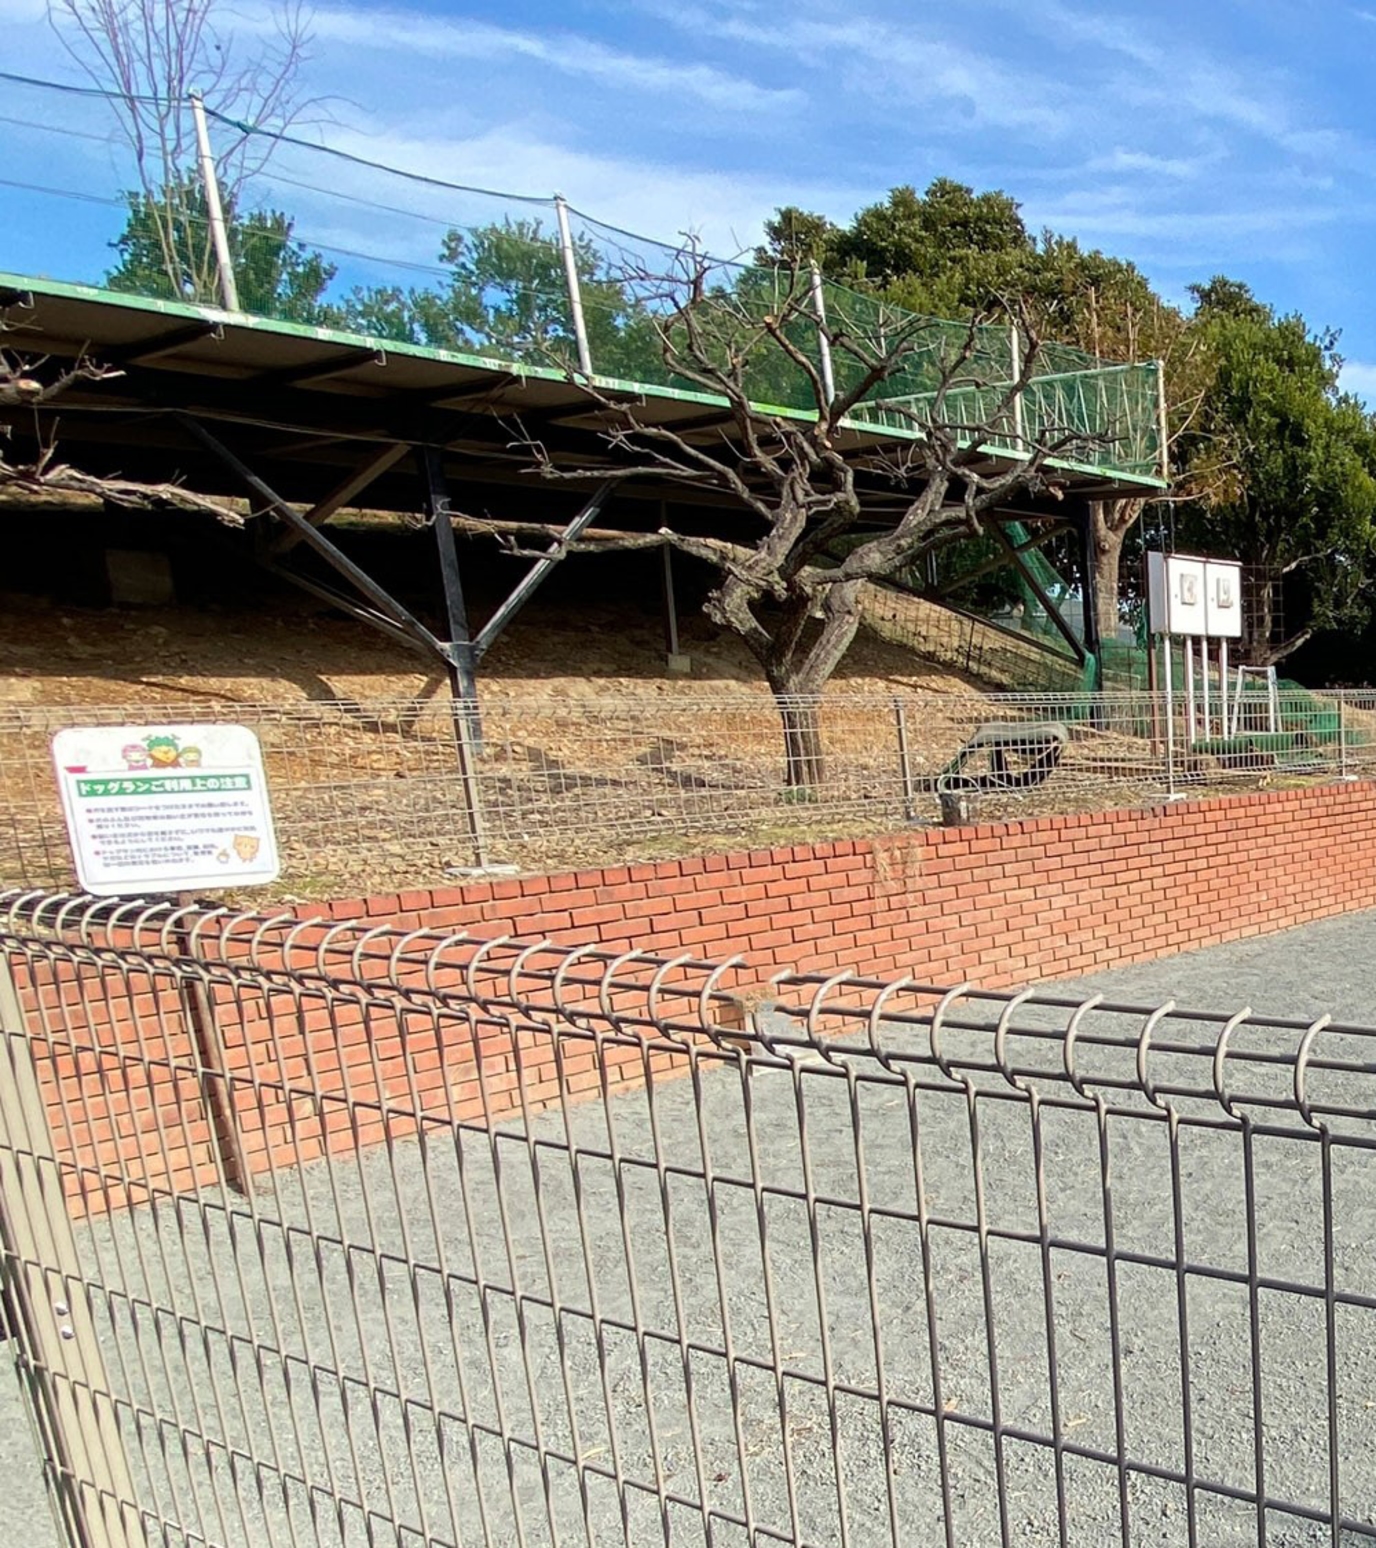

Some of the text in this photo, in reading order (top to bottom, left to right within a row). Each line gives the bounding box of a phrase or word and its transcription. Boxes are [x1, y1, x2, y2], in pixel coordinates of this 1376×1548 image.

[79, 776, 248, 795] ドッグランご利用上の注意
